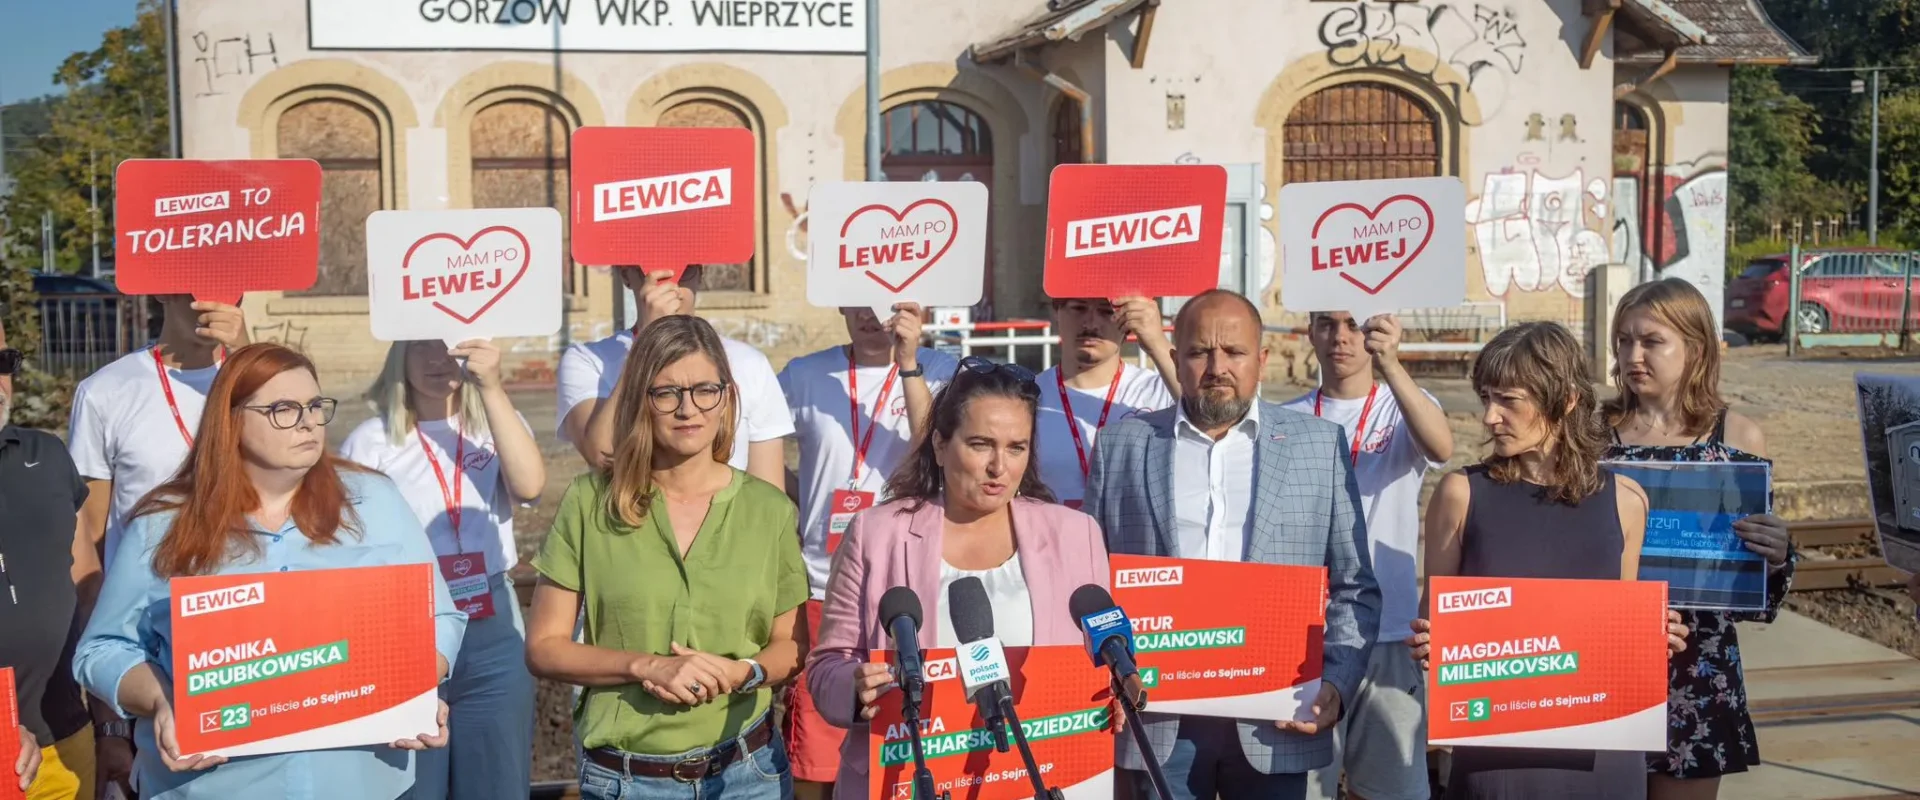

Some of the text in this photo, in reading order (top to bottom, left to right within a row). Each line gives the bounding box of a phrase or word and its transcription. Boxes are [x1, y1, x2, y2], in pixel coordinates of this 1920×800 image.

[595, 0, 673, 26] WKP.
[691, 0, 854, 27] WIEPRZYCE
[160, 187, 271, 213] LEWICA TO
[603, 175, 725, 214] LEWICA
[125, 211, 305, 254] TOLERANCJA
[880, 220, 947, 240] MAM PO
[1075, 212, 1193, 250] LEWICA
[1353, 216, 1422, 240] MAM PO
[447, 247, 518, 270] MAM PO
[839, 240, 930, 269] LEWEJ
[1311, 238, 1406, 271] LEWEJ
[402, 268, 502, 300] LEWEJ
[1120, 569, 1179, 585] LEWICA
[186, 586, 260, 612] LEWICA
[1443, 590, 1507, 609] LEWICA
[1129, 615, 1173, 632] RTUR
[1134, 629, 1244, 650] OJANOWSKI
[1441, 635, 1561, 662] MAGDALENA
[188, 637, 277, 671] MONIKA
[189, 645, 343, 692] DRUBKOWSKA
[970, 662, 1000, 676] polsat
[975, 671, 999, 682] news
[1142, 666, 1266, 685] 4 na liście do Sejmu RP
[1441, 654, 1576, 682] MILENKOVSKA
[223, 684, 376, 727] 23 na liście do Sejmu RP
[1473, 692, 1607, 718] 3 na liście do Sejmu RP
[884, 711, 1110, 763] KUHARSK-DZIEDZIC
[885, 716, 945, 740] ANTA
[937, 763, 1054, 791] na liście do Sejm RP
